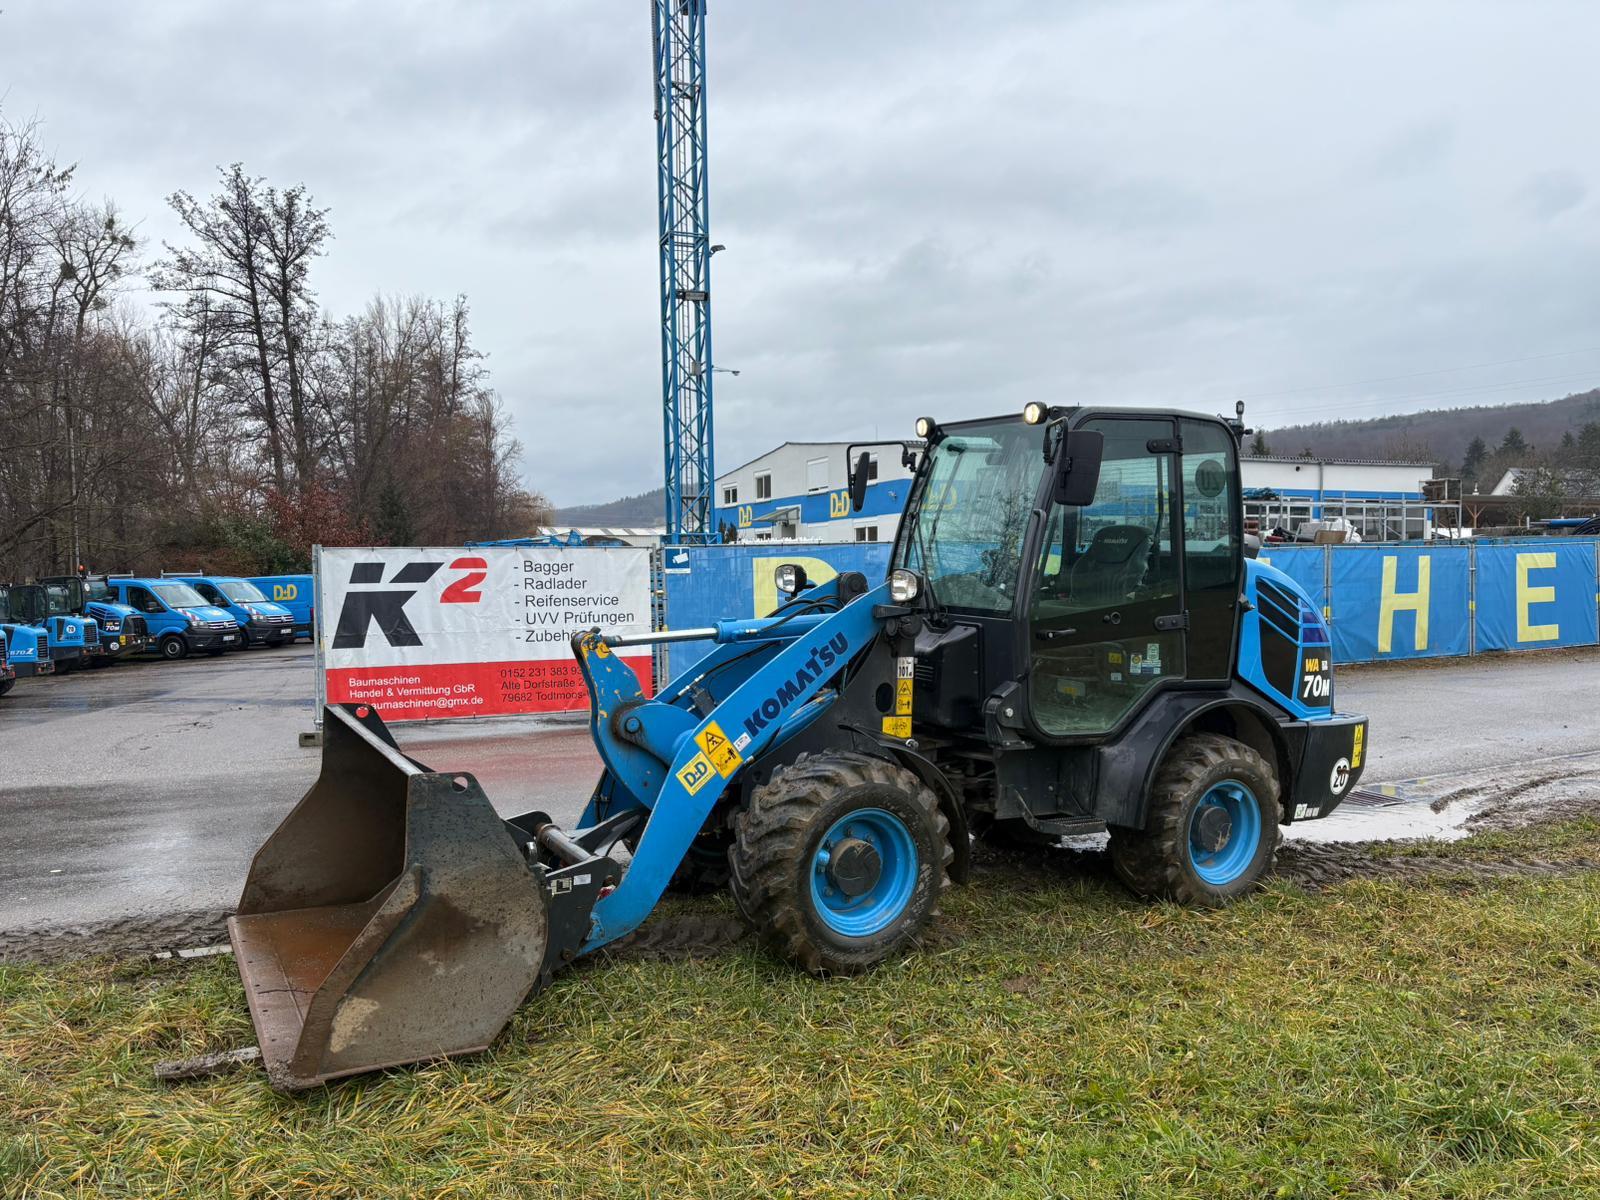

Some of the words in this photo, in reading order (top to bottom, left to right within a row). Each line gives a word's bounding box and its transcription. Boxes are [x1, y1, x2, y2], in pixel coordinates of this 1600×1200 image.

[523, 560, 574, 575] Bagger
[524, 578, 587, 589] Radlader
[525, 594, 619, 607] Reifenservice
[526, 612, 559, 625] UVV
[564, 611, 634, 625] Prüfungen
[525, 630, 577, 643] Zubehö
[500, 668, 526, 678] 0152
[528, 667, 546, 677] 231
[550, 666, 568, 676] 383
[1305, 658, 1320, 673] WA
[348, 676, 421, 687] Baumaschinen
[501, 681, 521, 690] Alte
[523, 678, 576, 690] Dorfstraße
[743, 631, 849, 737] KOMATSU
[1303, 675, 1330, 698] 70M
[349, 688, 384, 698] Handel
[386, 687, 394, 697] &
[396, 685, 451, 696] Vermittlung
[453, 683, 476, 694] GbR
[501, 692, 533, 703] 79682
